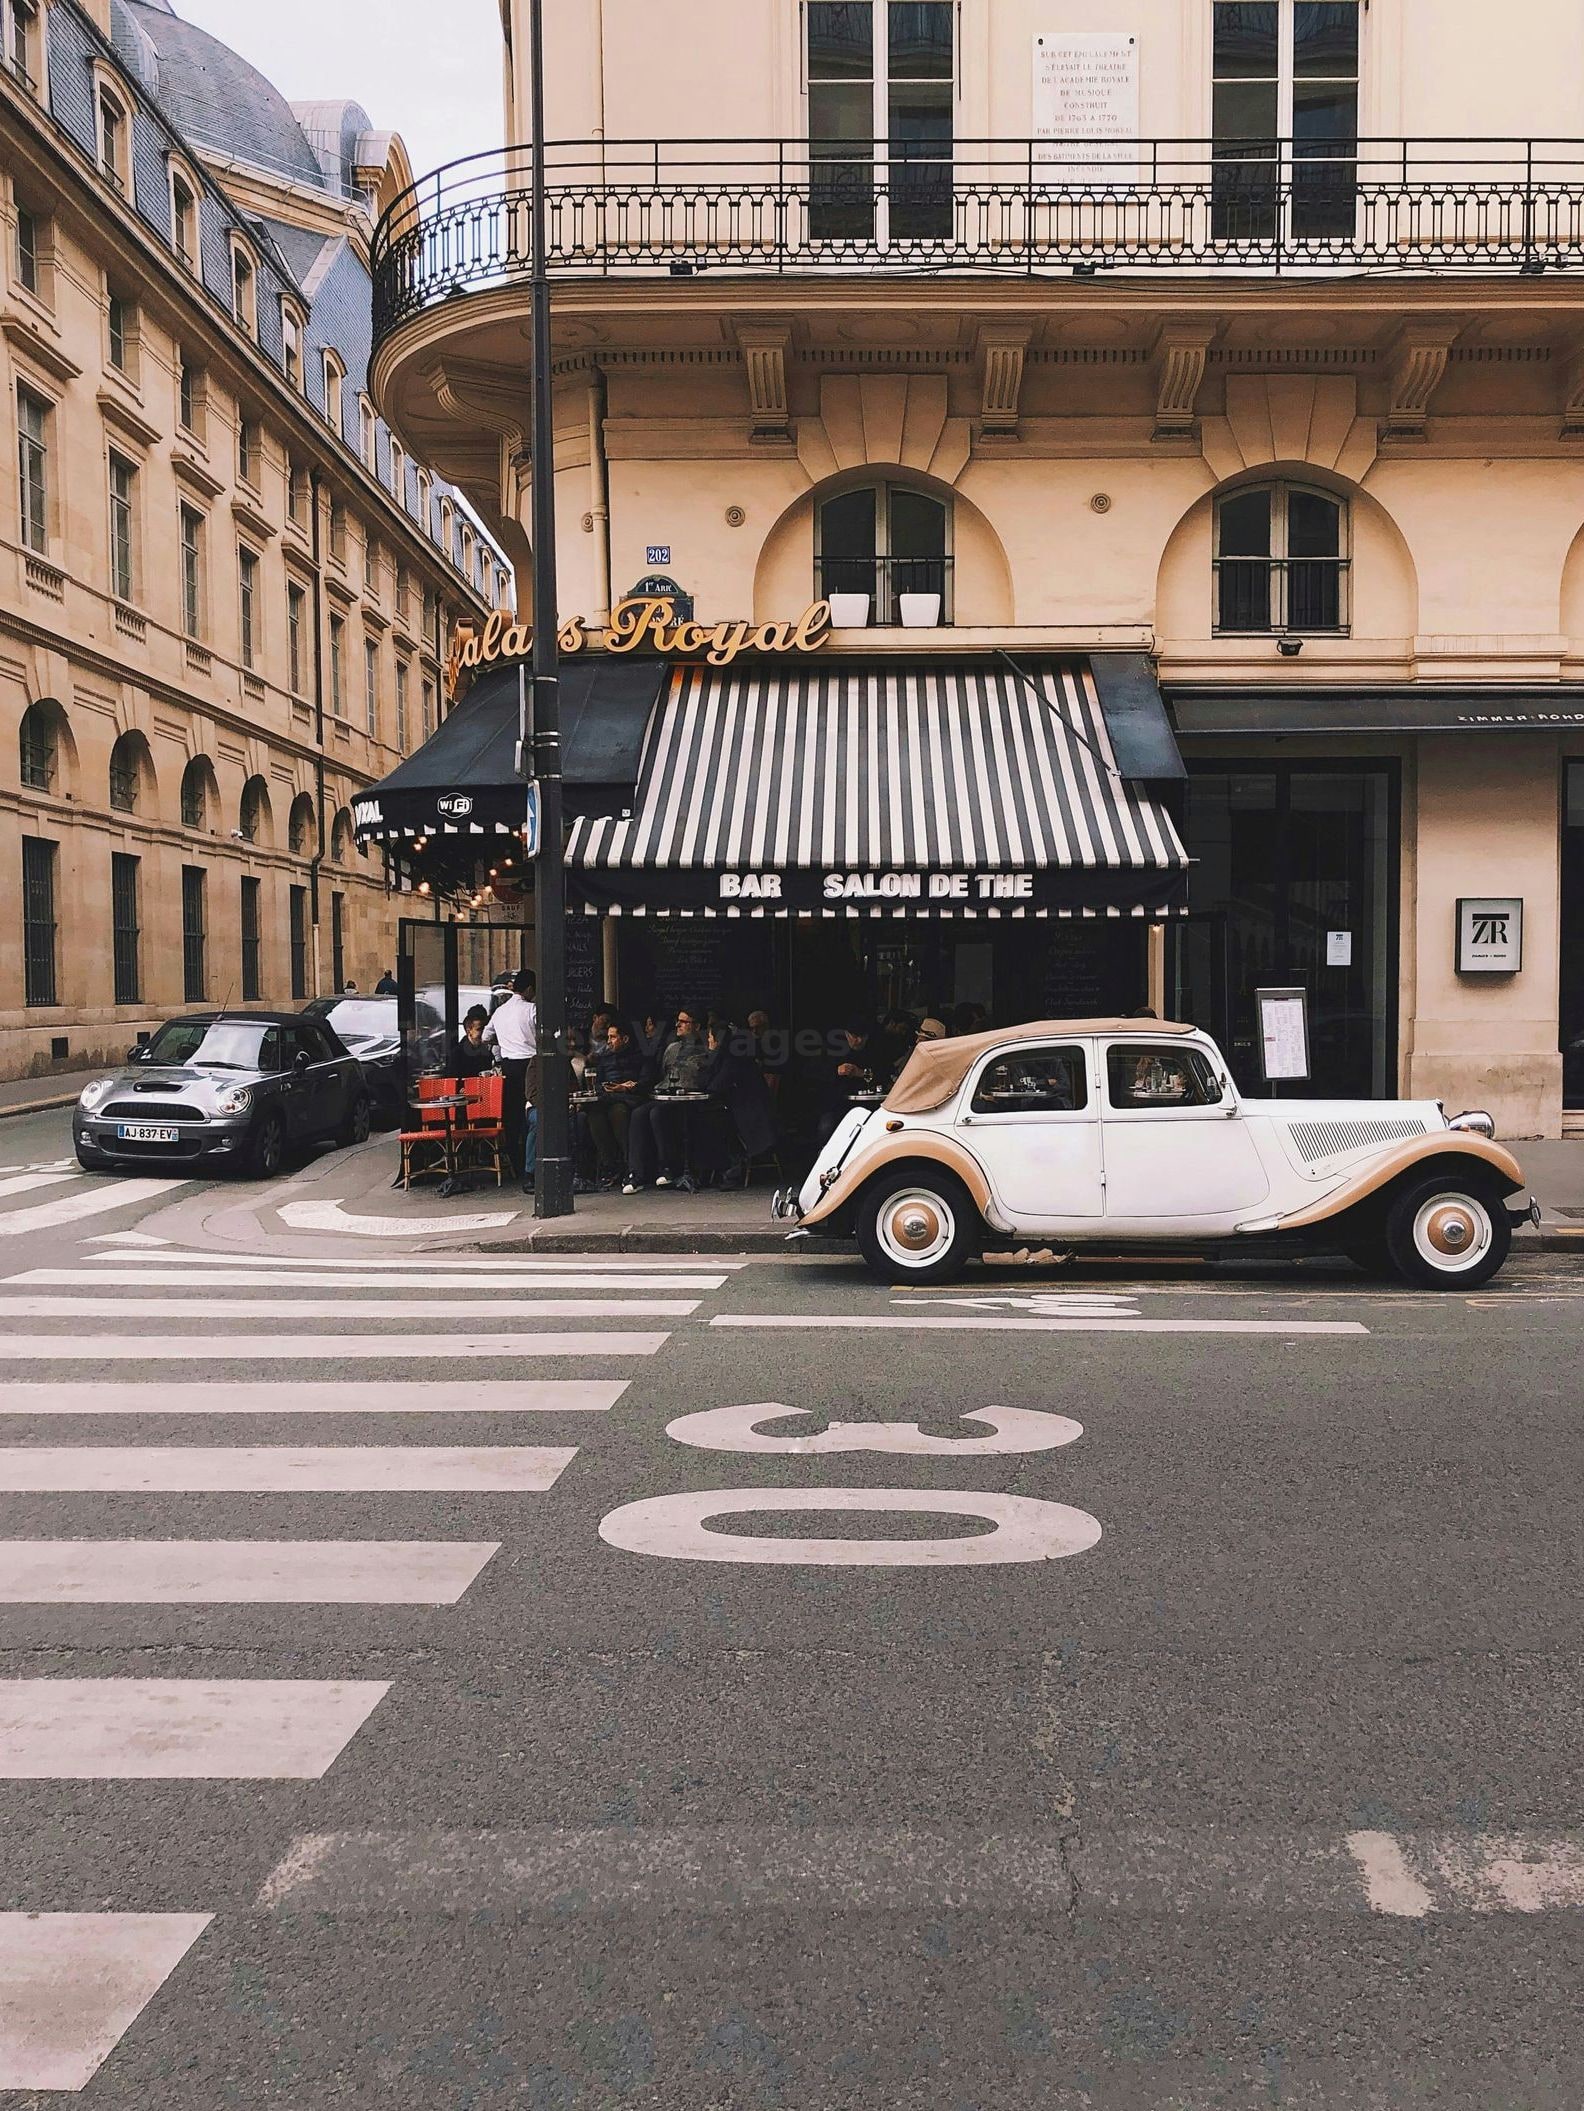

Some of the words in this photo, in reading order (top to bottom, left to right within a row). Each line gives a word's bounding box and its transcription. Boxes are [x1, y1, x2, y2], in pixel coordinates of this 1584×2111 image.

[648, 548, 668, 562] 202
[450, 609, 584, 690] alas
[603, 597, 830, 666] Royal
[1457, 714, 1528, 722] ZIMMER
[719, 873, 783, 898] BAR
[823, 873, 921, 898] SALON
[929, 873, 969, 898] DE
[975, 873, 1033, 898] THE
[1472, 920, 1508, 943] ZR
